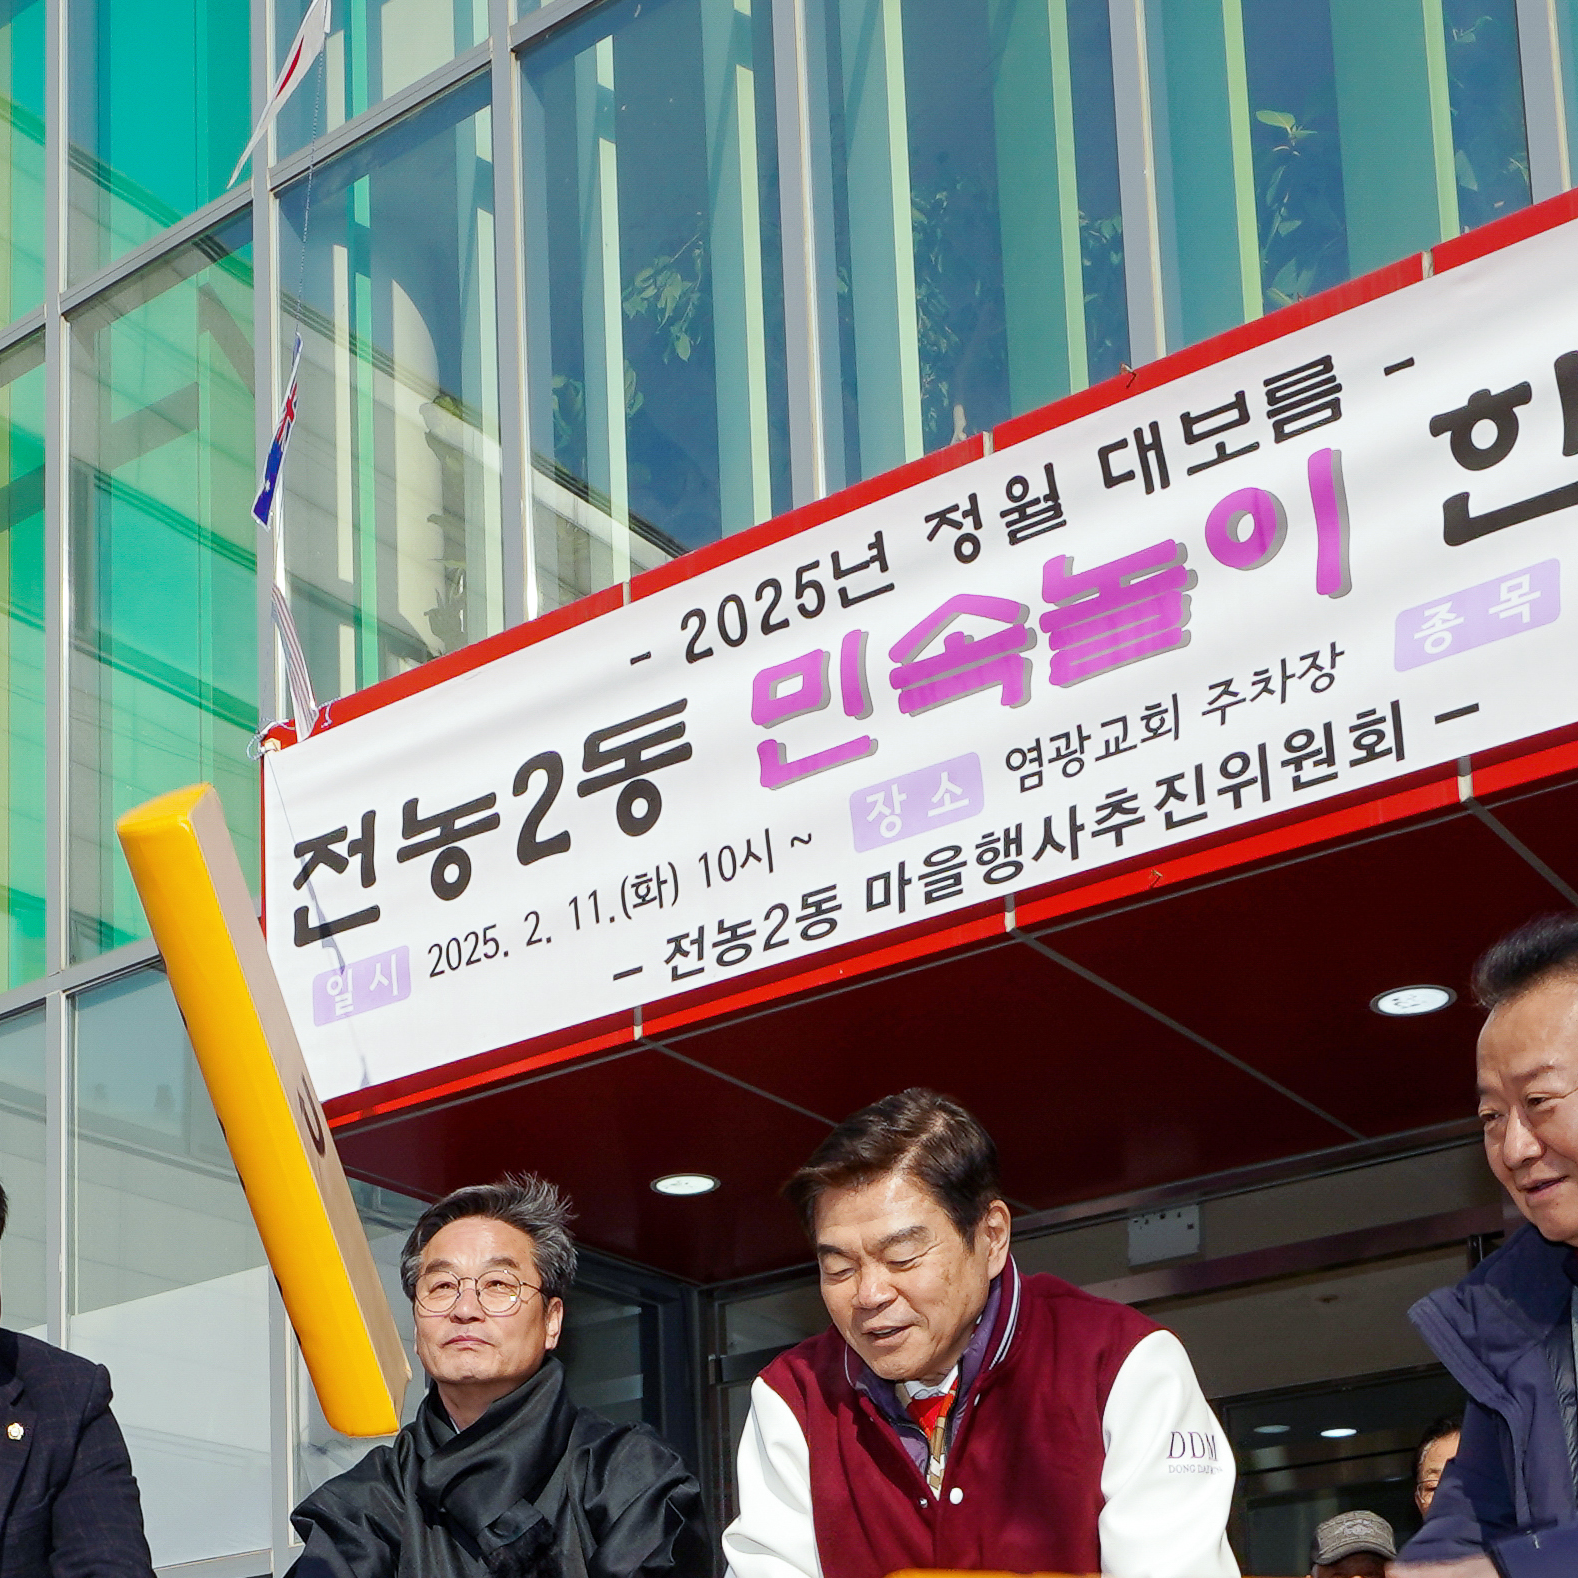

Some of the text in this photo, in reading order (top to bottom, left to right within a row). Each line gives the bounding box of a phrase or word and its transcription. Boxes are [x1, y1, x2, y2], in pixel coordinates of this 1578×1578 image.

[679, 529, 897, 661] 2025년
[923, 461, 1069, 566] 정월
[1097, 352, 1344, 499] 대보름
[290, 694, 695, 949] 전농2동
[750, 446, 1354, 792] 민속놀이
[427, 924, 509, 978] 2025.
[524, 910, 553, 948] 2.
[568, 861, 680, 932] 11.(화)
[698, 827, 775, 888] 10시
[1004, 694, 1181, 794] 염광교회
[1200, 641, 1345, 726] 주차장
[663, 883, 844, 983] 전농2동
[865, 699, 1407, 913] 마을행사추진위원회
[1166, 1431, 1218, 1461] DDM
